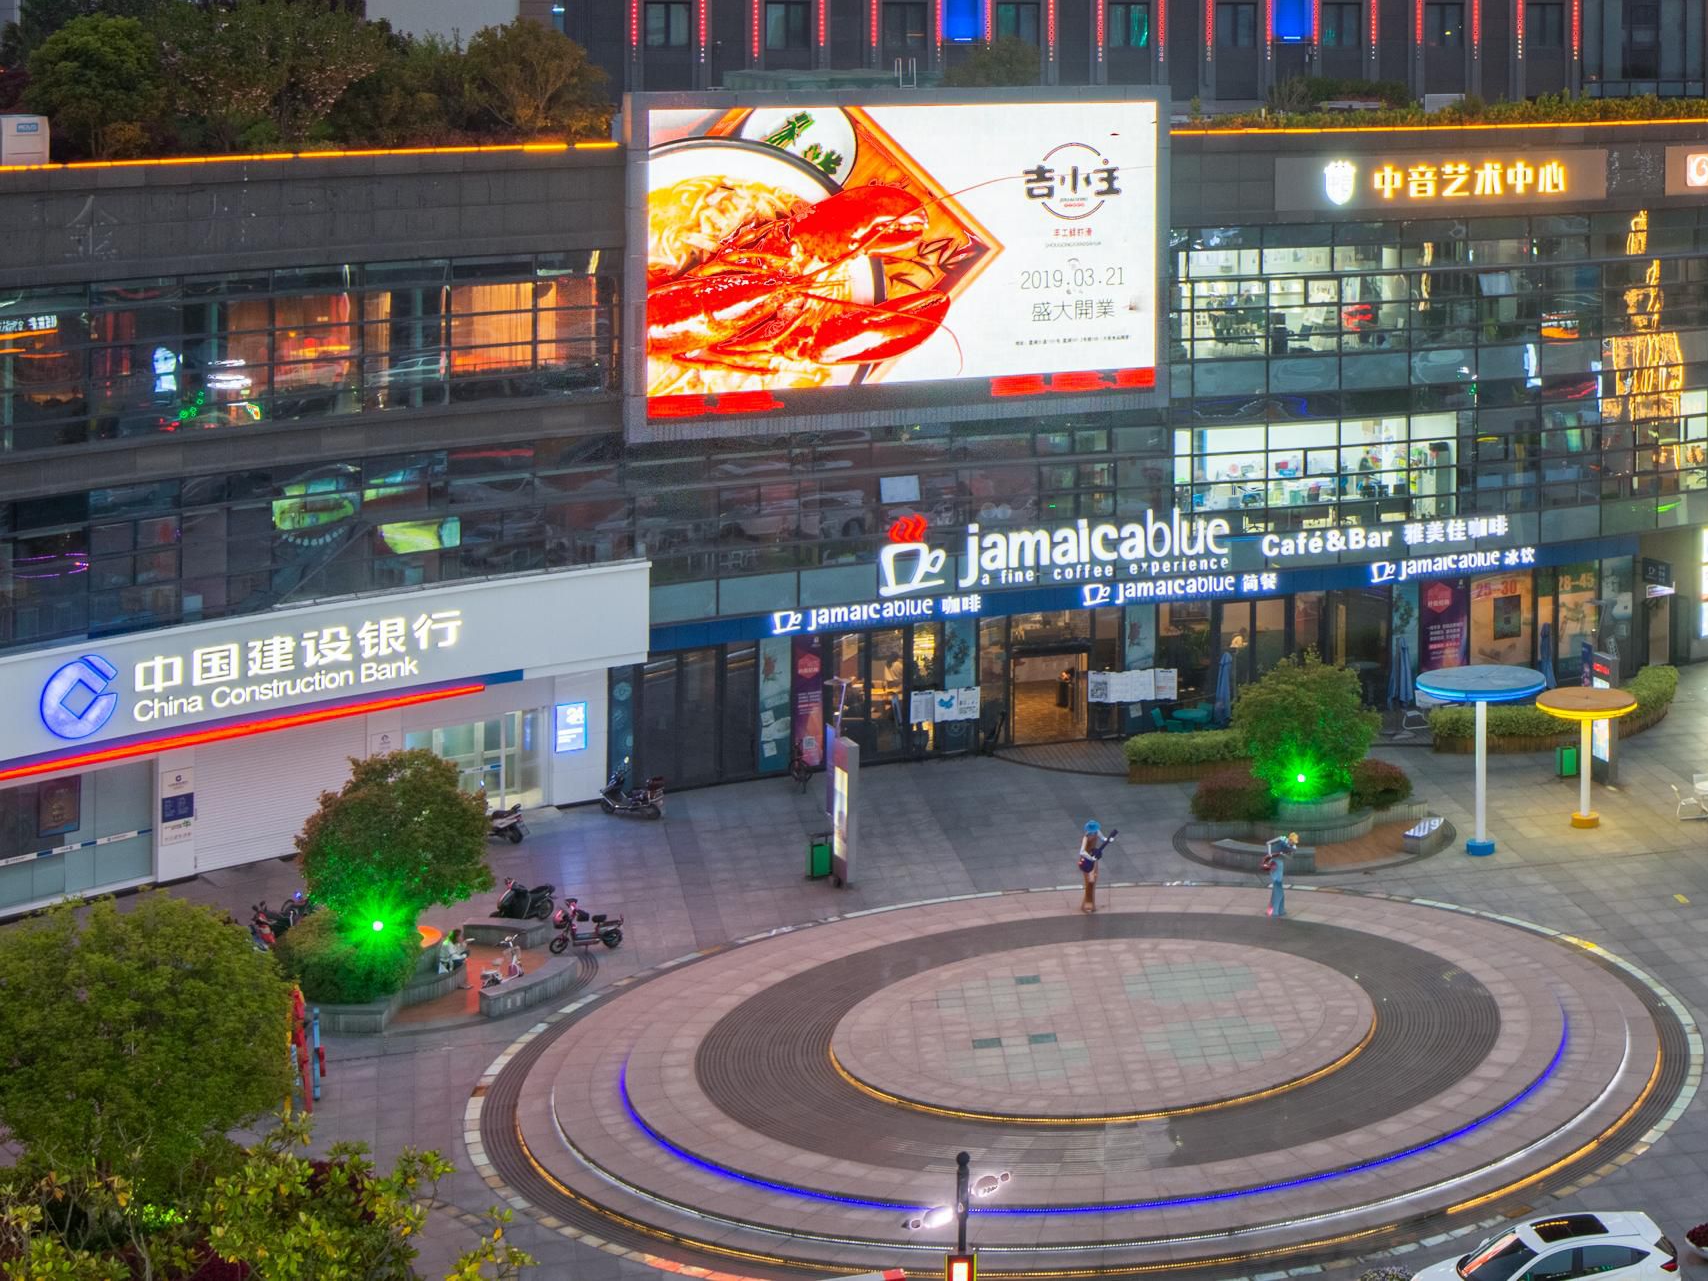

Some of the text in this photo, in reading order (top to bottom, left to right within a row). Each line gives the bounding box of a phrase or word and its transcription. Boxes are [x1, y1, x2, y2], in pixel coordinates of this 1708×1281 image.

[1373, 160, 1567, 200] 中音艺术中心
[1020, 266, 1125, 291] 2019.03.21
[1031, 298, 1116, 323] 盛大開業
[1403, 514, 1510, 545] 雅美佳咖啡
[958, 507, 1231, 589] jamaicablue
[1397, 550, 1501, 581] jamaicablue
[1503, 546, 1536, 566] 冰饮
[981, 557, 1231, 586] a fine coffee experience
[1114, 574, 1236, 605] jamaicablue
[1241, 572, 1278, 593] 简餐
[806, 593, 983, 632] jamaicablue 咖啡
[133, 609, 463, 694] 中国建设银行
[133, 655, 419, 723] China Construction Bank
